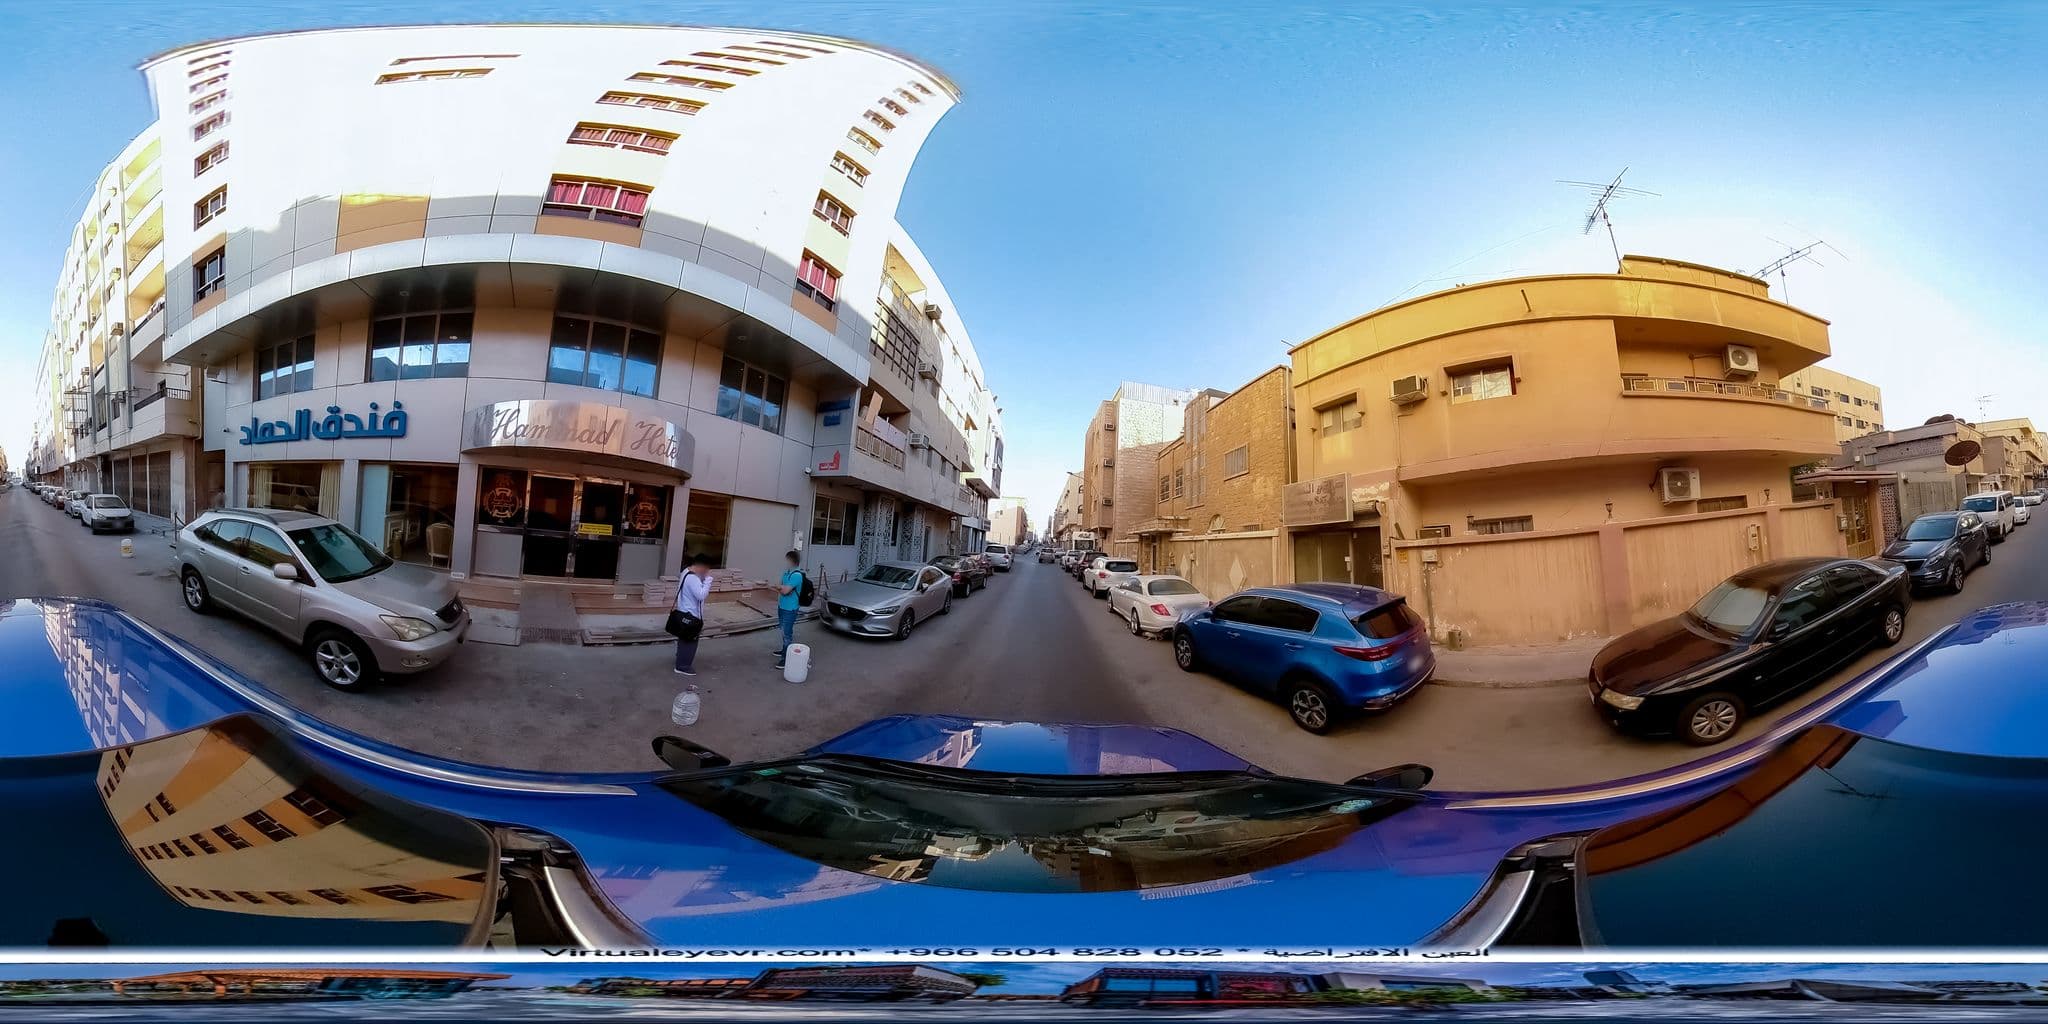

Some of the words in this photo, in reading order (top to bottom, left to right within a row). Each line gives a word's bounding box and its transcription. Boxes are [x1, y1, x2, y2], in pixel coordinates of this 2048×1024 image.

[239, 408, 312, 446] الحماد
[312, 400, 408, 440] فندق
[491, 408, 619, 446] Hamad
[631, 420, 681, 461] Hote
